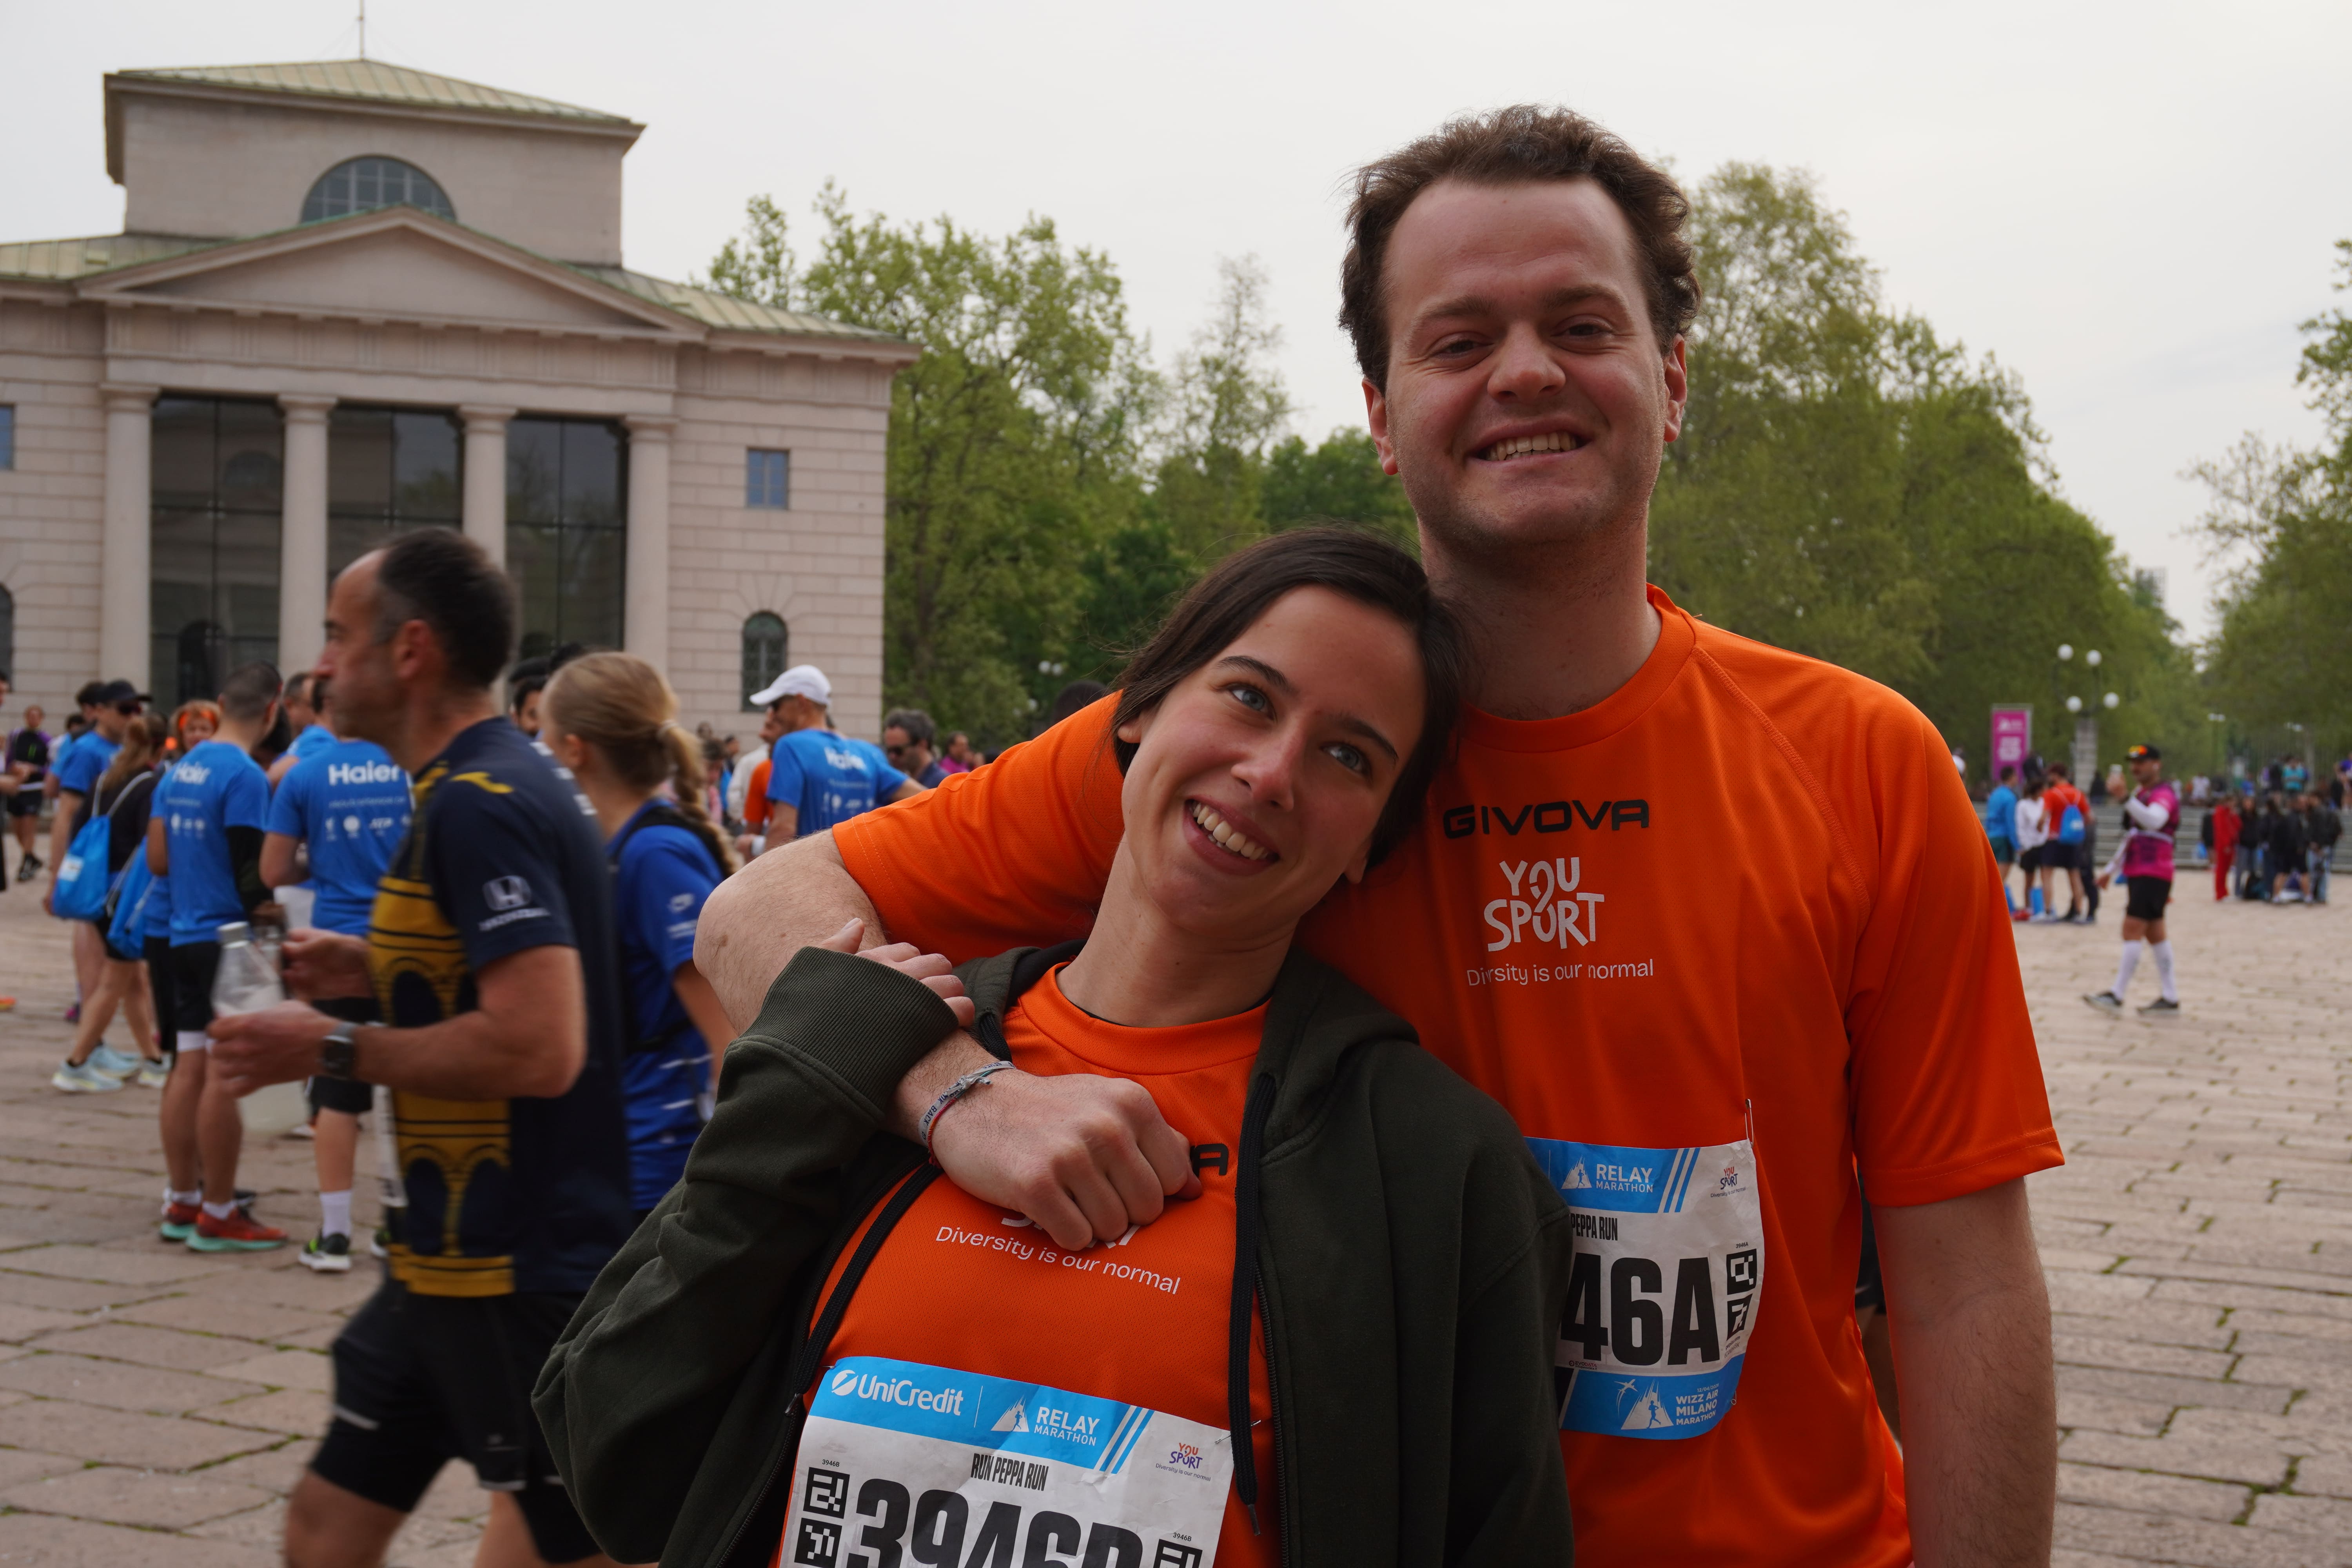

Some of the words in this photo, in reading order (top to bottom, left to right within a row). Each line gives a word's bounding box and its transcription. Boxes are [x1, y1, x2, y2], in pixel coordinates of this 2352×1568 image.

[328, 760, 400, 786] Haier
[1443, 799, 1650, 839] GIVOVA
[1499, 857, 1580, 913] YOU
[1484, 892, 1605, 952] SPORT
[1533, 964, 1550, 982] is
[1554, 964, 1583, 980] our
[1588, 959, 1654, 979] normal
[923, 1105, 938, 1126] BACK
[1596, 1163, 1653, 1183] RELAY
[1720, 1173, 1738, 1190] SPORT
[1724, 1166, 1734, 1178] YOU
[1596, 1180, 1653, 1193] MARATHON
[1599, 1216, 1618, 1241] RUN
[936, 1226, 1034, 1261] Diversity
[1038, 1247, 1057, 1263] is
[1062, 1255, 1100, 1271] our
[1102, 1262, 1181, 1295] normal
[858, 1373, 964, 1416] UniCredit
[1675, 1394, 1704, 1405] WIZZ
[1706, 1389, 1719, 1401] AIR
[1676, 1399, 1717, 1417] MILANO
[1676, 1410, 1716, 1426] MARATHON
[1036, 1406, 1100, 1435] RELAY
[1034, 1424, 1097, 1446] MARATHON
[1179, 1442, 1199, 1457] YOU
[822, 1459, 840, 1467] 3946B
[1169, 1451, 1203, 1469] SPORT
[971, 1453, 994, 1481] RUN
[992, 1457, 1025, 1487] PEPPA
[1024, 1462, 1049, 1491] RUN
[1156, 1463, 1178, 1473] Diversity
[1193, 1473, 1211, 1482] normal
[1172, 1532, 1192, 1542] 3946B
